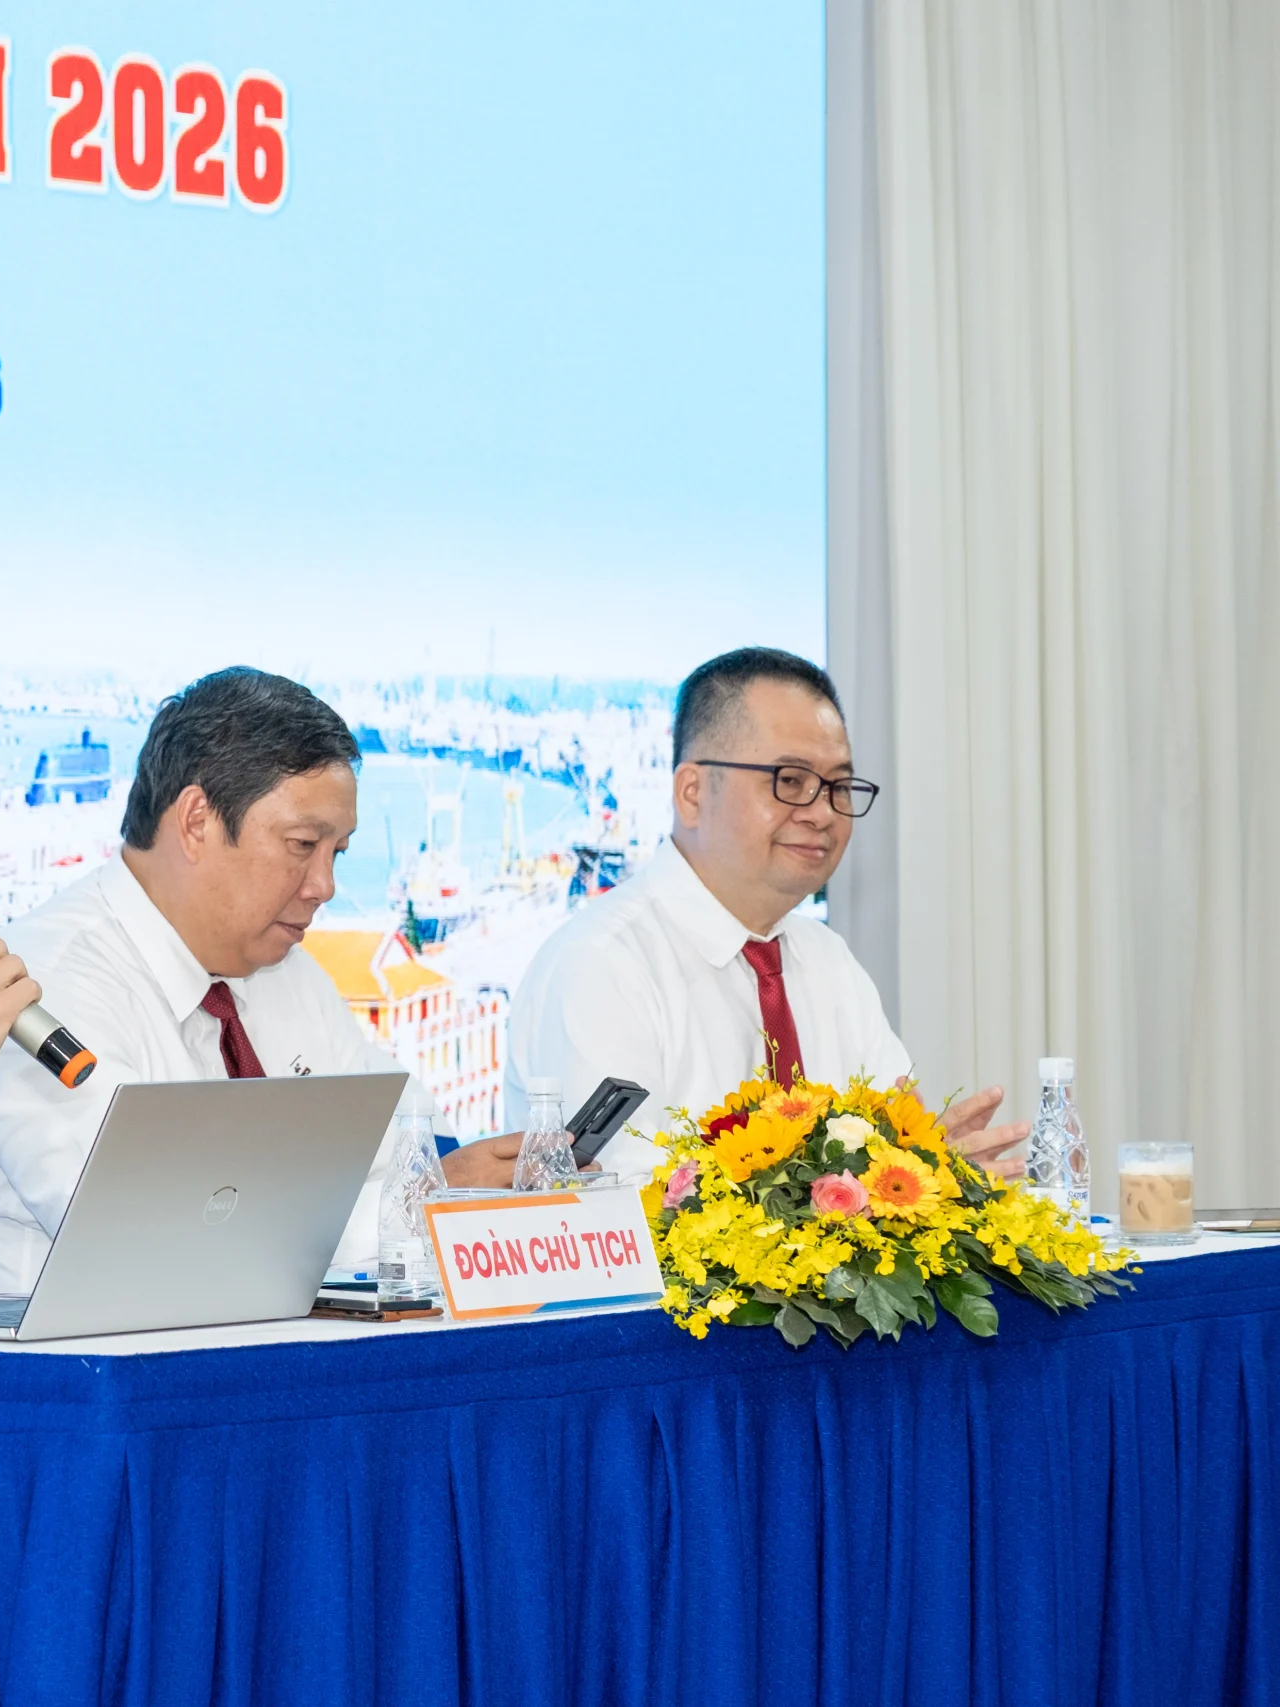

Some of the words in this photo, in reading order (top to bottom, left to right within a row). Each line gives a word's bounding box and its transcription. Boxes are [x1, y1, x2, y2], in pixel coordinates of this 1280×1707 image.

[49, 54, 284, 205] 2026
[453, 1229, 528, 1280] ĐOÀN
[528, 1221, 581, 1274] CHỦ
[581, 1230, 641, 1279] TỊCH
